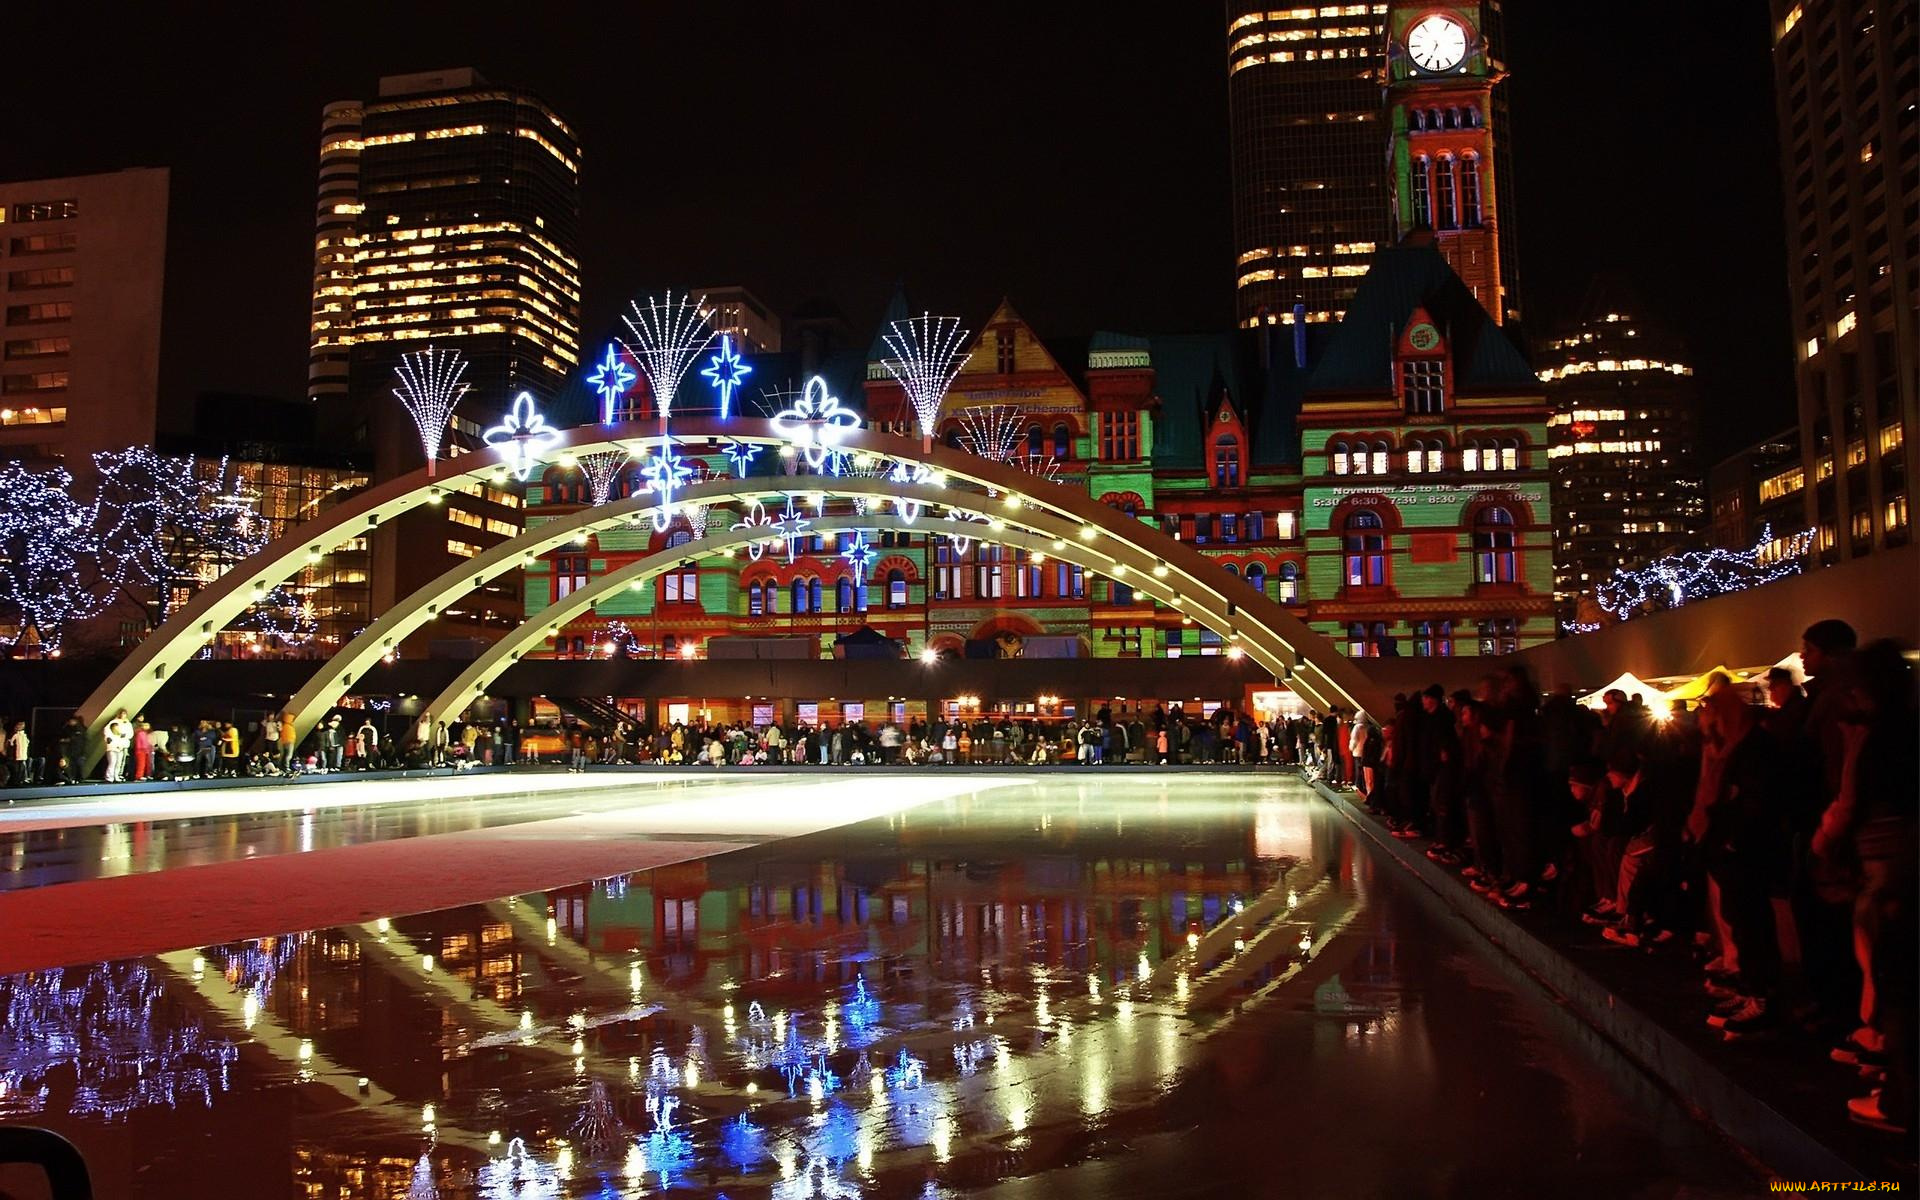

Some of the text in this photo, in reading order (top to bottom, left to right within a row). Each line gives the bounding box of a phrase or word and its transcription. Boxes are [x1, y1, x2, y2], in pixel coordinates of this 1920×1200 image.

[1333, 486, 1395, 495] November
[1420, 485, 1432, 493] to
[1313, 498, 1340, 507] 5:30
[1350, 497, 1378, 505] 6:30
[1390, 496, 1417, 504] 7:30
[1428, 494, 1456, 504] 8:30
